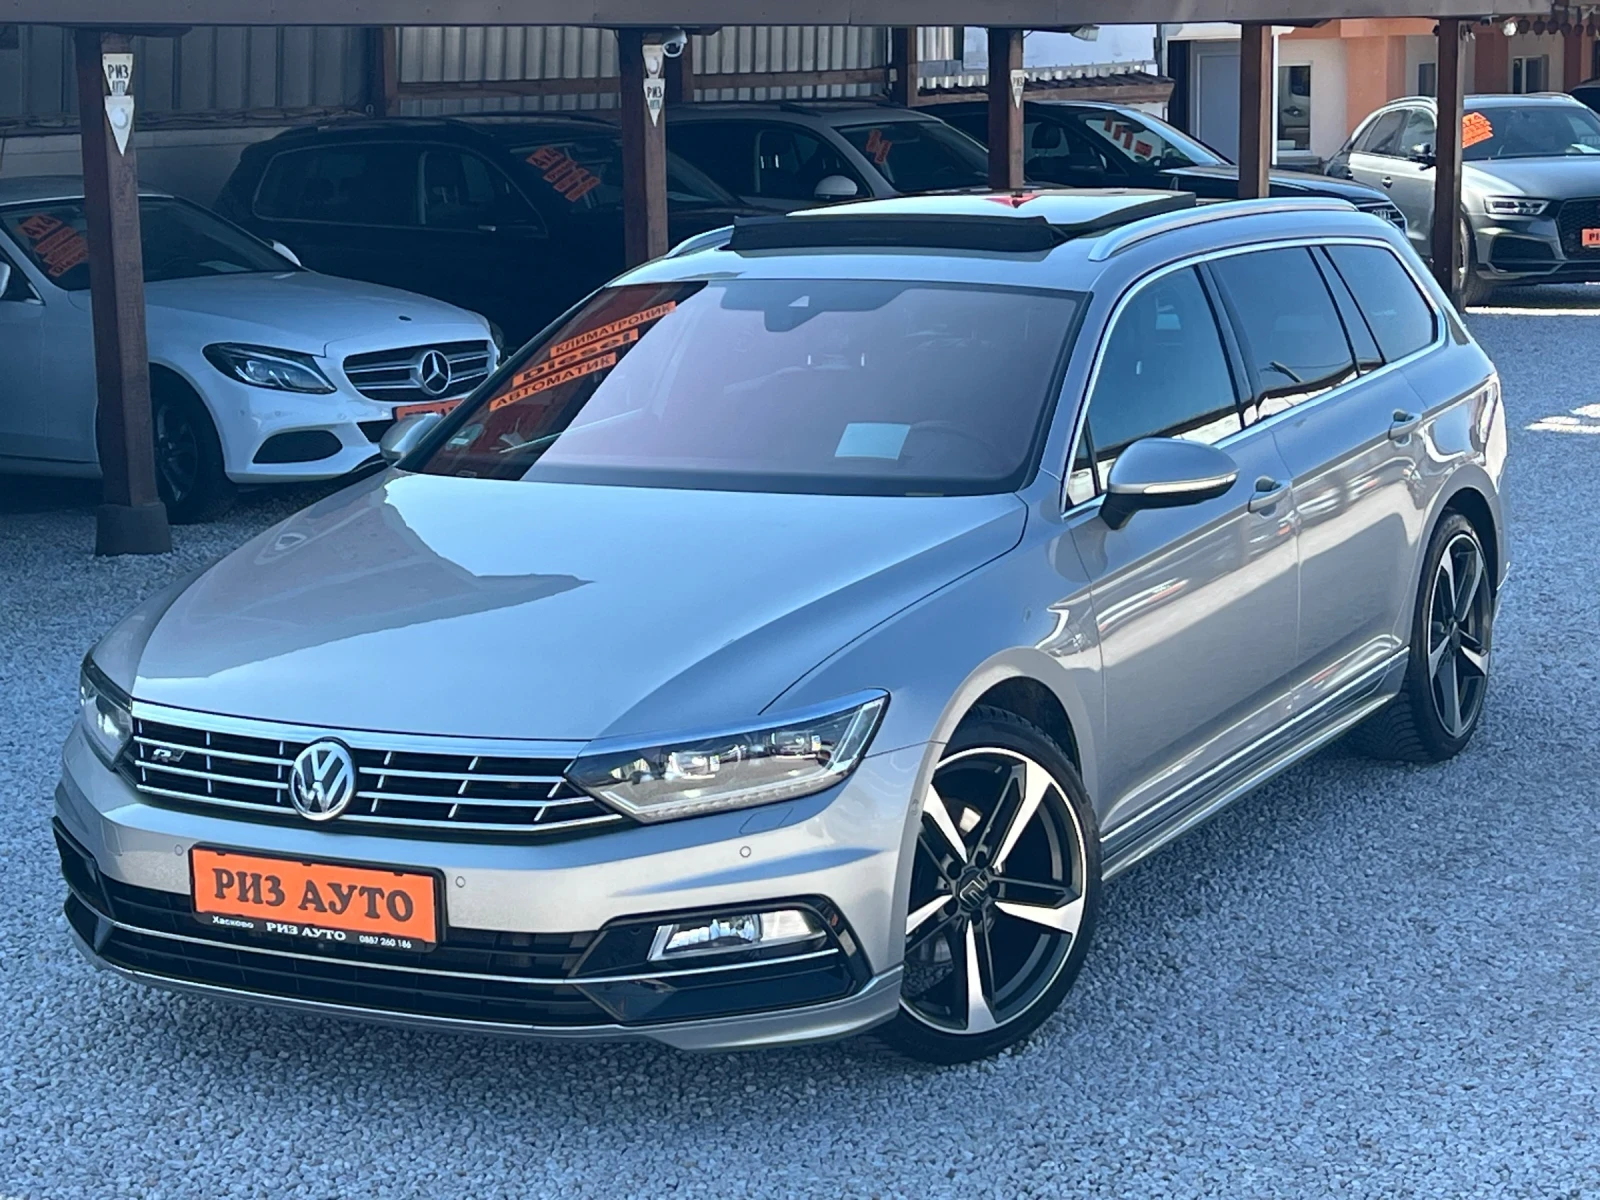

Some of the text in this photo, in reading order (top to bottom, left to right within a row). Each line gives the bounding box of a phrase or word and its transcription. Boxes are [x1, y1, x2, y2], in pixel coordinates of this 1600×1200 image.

[555, 305, 671, 354] КЛИМАТРОНИК
[522, 332, 632, 381] Diesel
[495, 355, 612, 408] АВТОМАТИК
[212, 867, 414, 922] РИЗ АУТО
[212, 915, 255, 929] Хасково
[265, 921, 299, 935] РИЗ
[301, 927, 347, 942] АУТО
